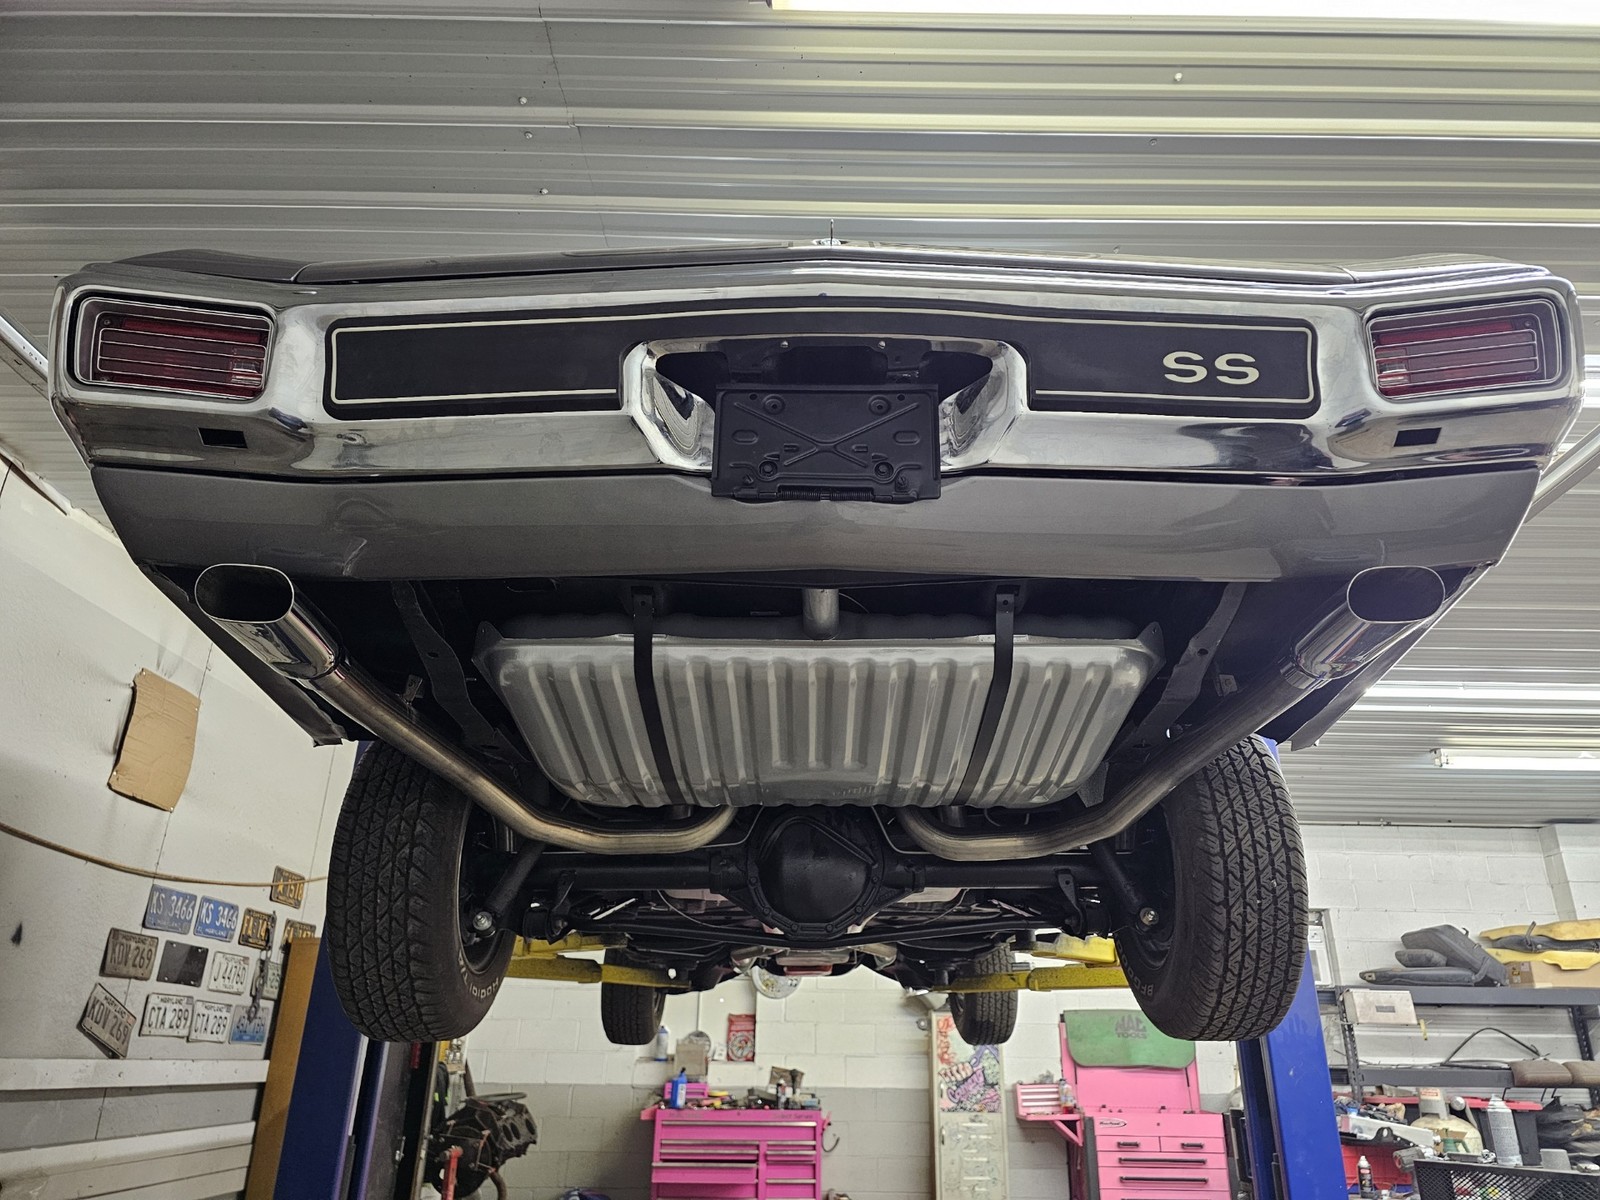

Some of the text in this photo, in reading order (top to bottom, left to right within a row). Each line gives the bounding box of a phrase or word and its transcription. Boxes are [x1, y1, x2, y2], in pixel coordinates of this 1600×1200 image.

[1162, 351, 1260, 385] SS
[150, 890, 194, 921] KS 3466
[201, 901, 238, 930] KS 3466
[110, 941, 153, 970] KDV 269
[87, 996, 129, 1046] KDV 269
[148, 1006, 189, 1029] CTA 289
[194, 1012, 210, 1035] CTA
[210, 1015, 228, 1036] 289
